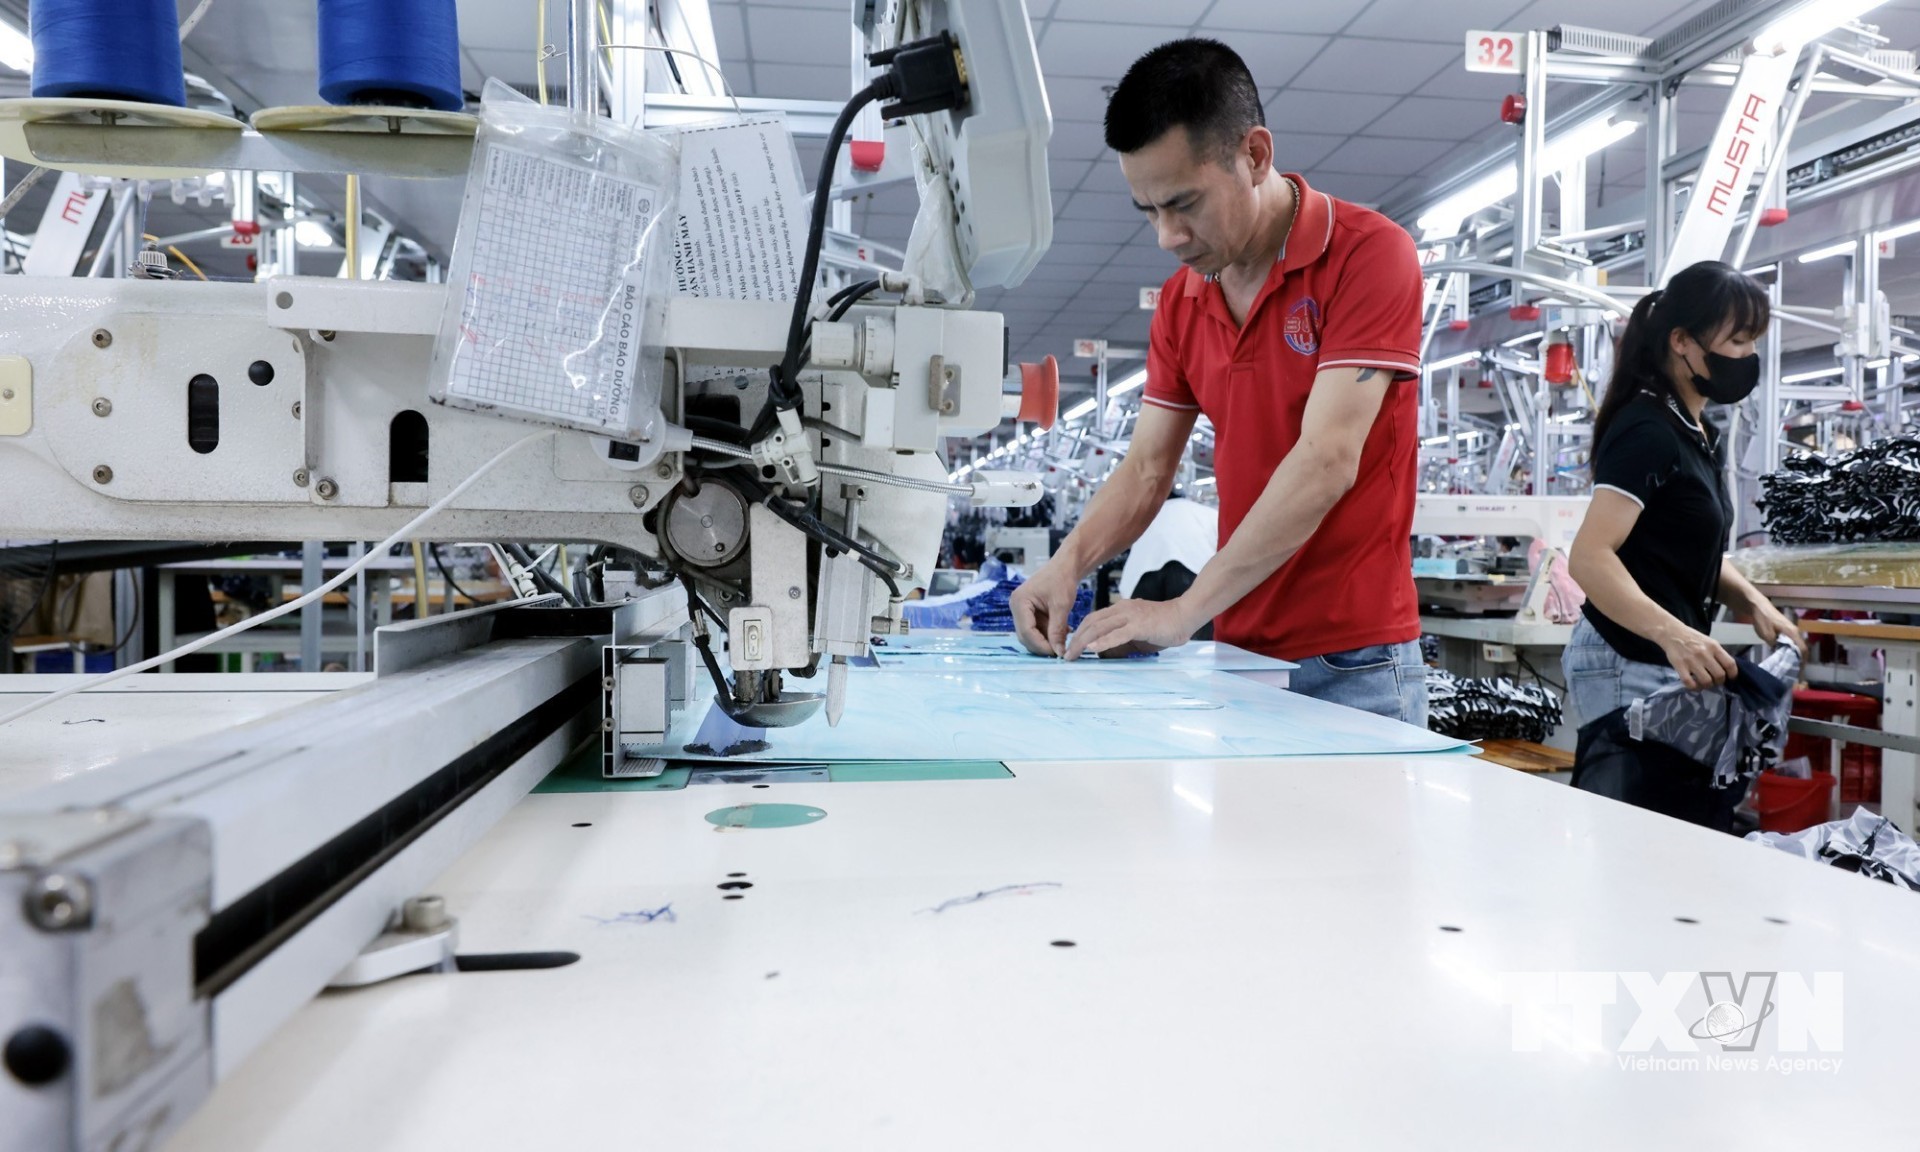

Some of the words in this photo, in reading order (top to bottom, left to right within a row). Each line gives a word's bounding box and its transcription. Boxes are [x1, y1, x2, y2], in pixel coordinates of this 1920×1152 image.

[1478, 37, 1513, 67] 32
[1706, 93, 1767, 216] MUSTA
[734, 189, 742, 203] OFF
[679, 215, 689, 238] MÁY
[683, 242, 695, 273] HÀNH
[623, 284, 635, 309] BÁO
[619, 313, 631, 338] CÁO
